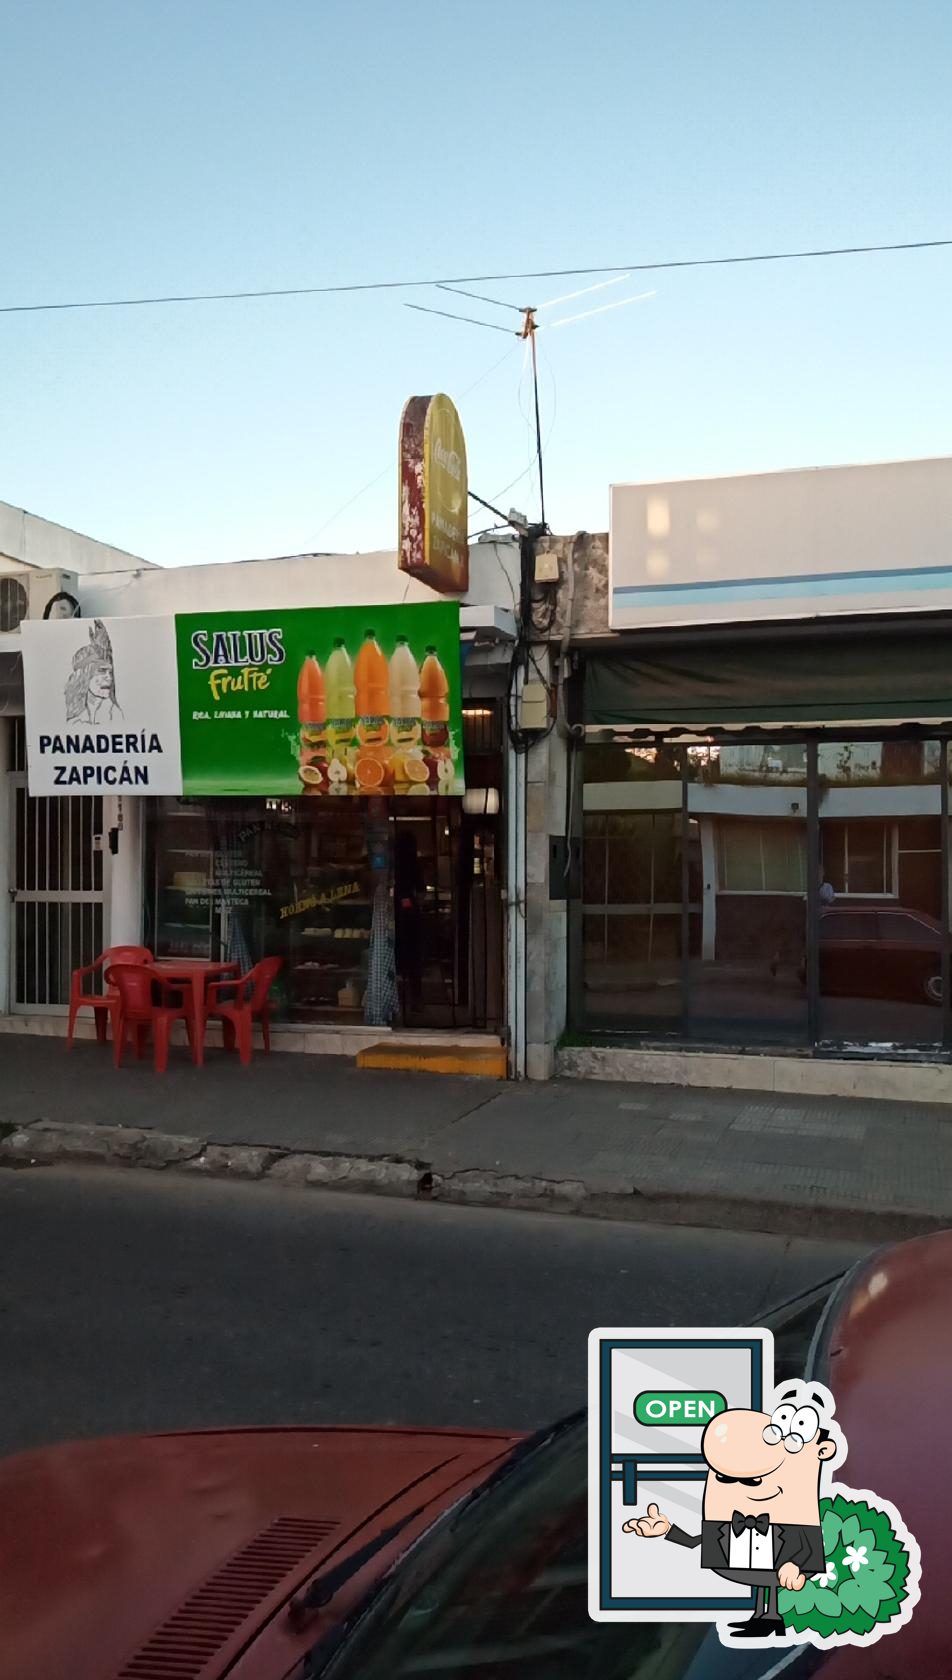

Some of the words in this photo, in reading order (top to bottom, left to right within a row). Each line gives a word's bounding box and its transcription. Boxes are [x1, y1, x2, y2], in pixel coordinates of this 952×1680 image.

[191, 628, 286, 670] SALUS
[39, 728, 163, 754] PANADERÍA
[53, 760, 149, 786] ZAPICÁN
